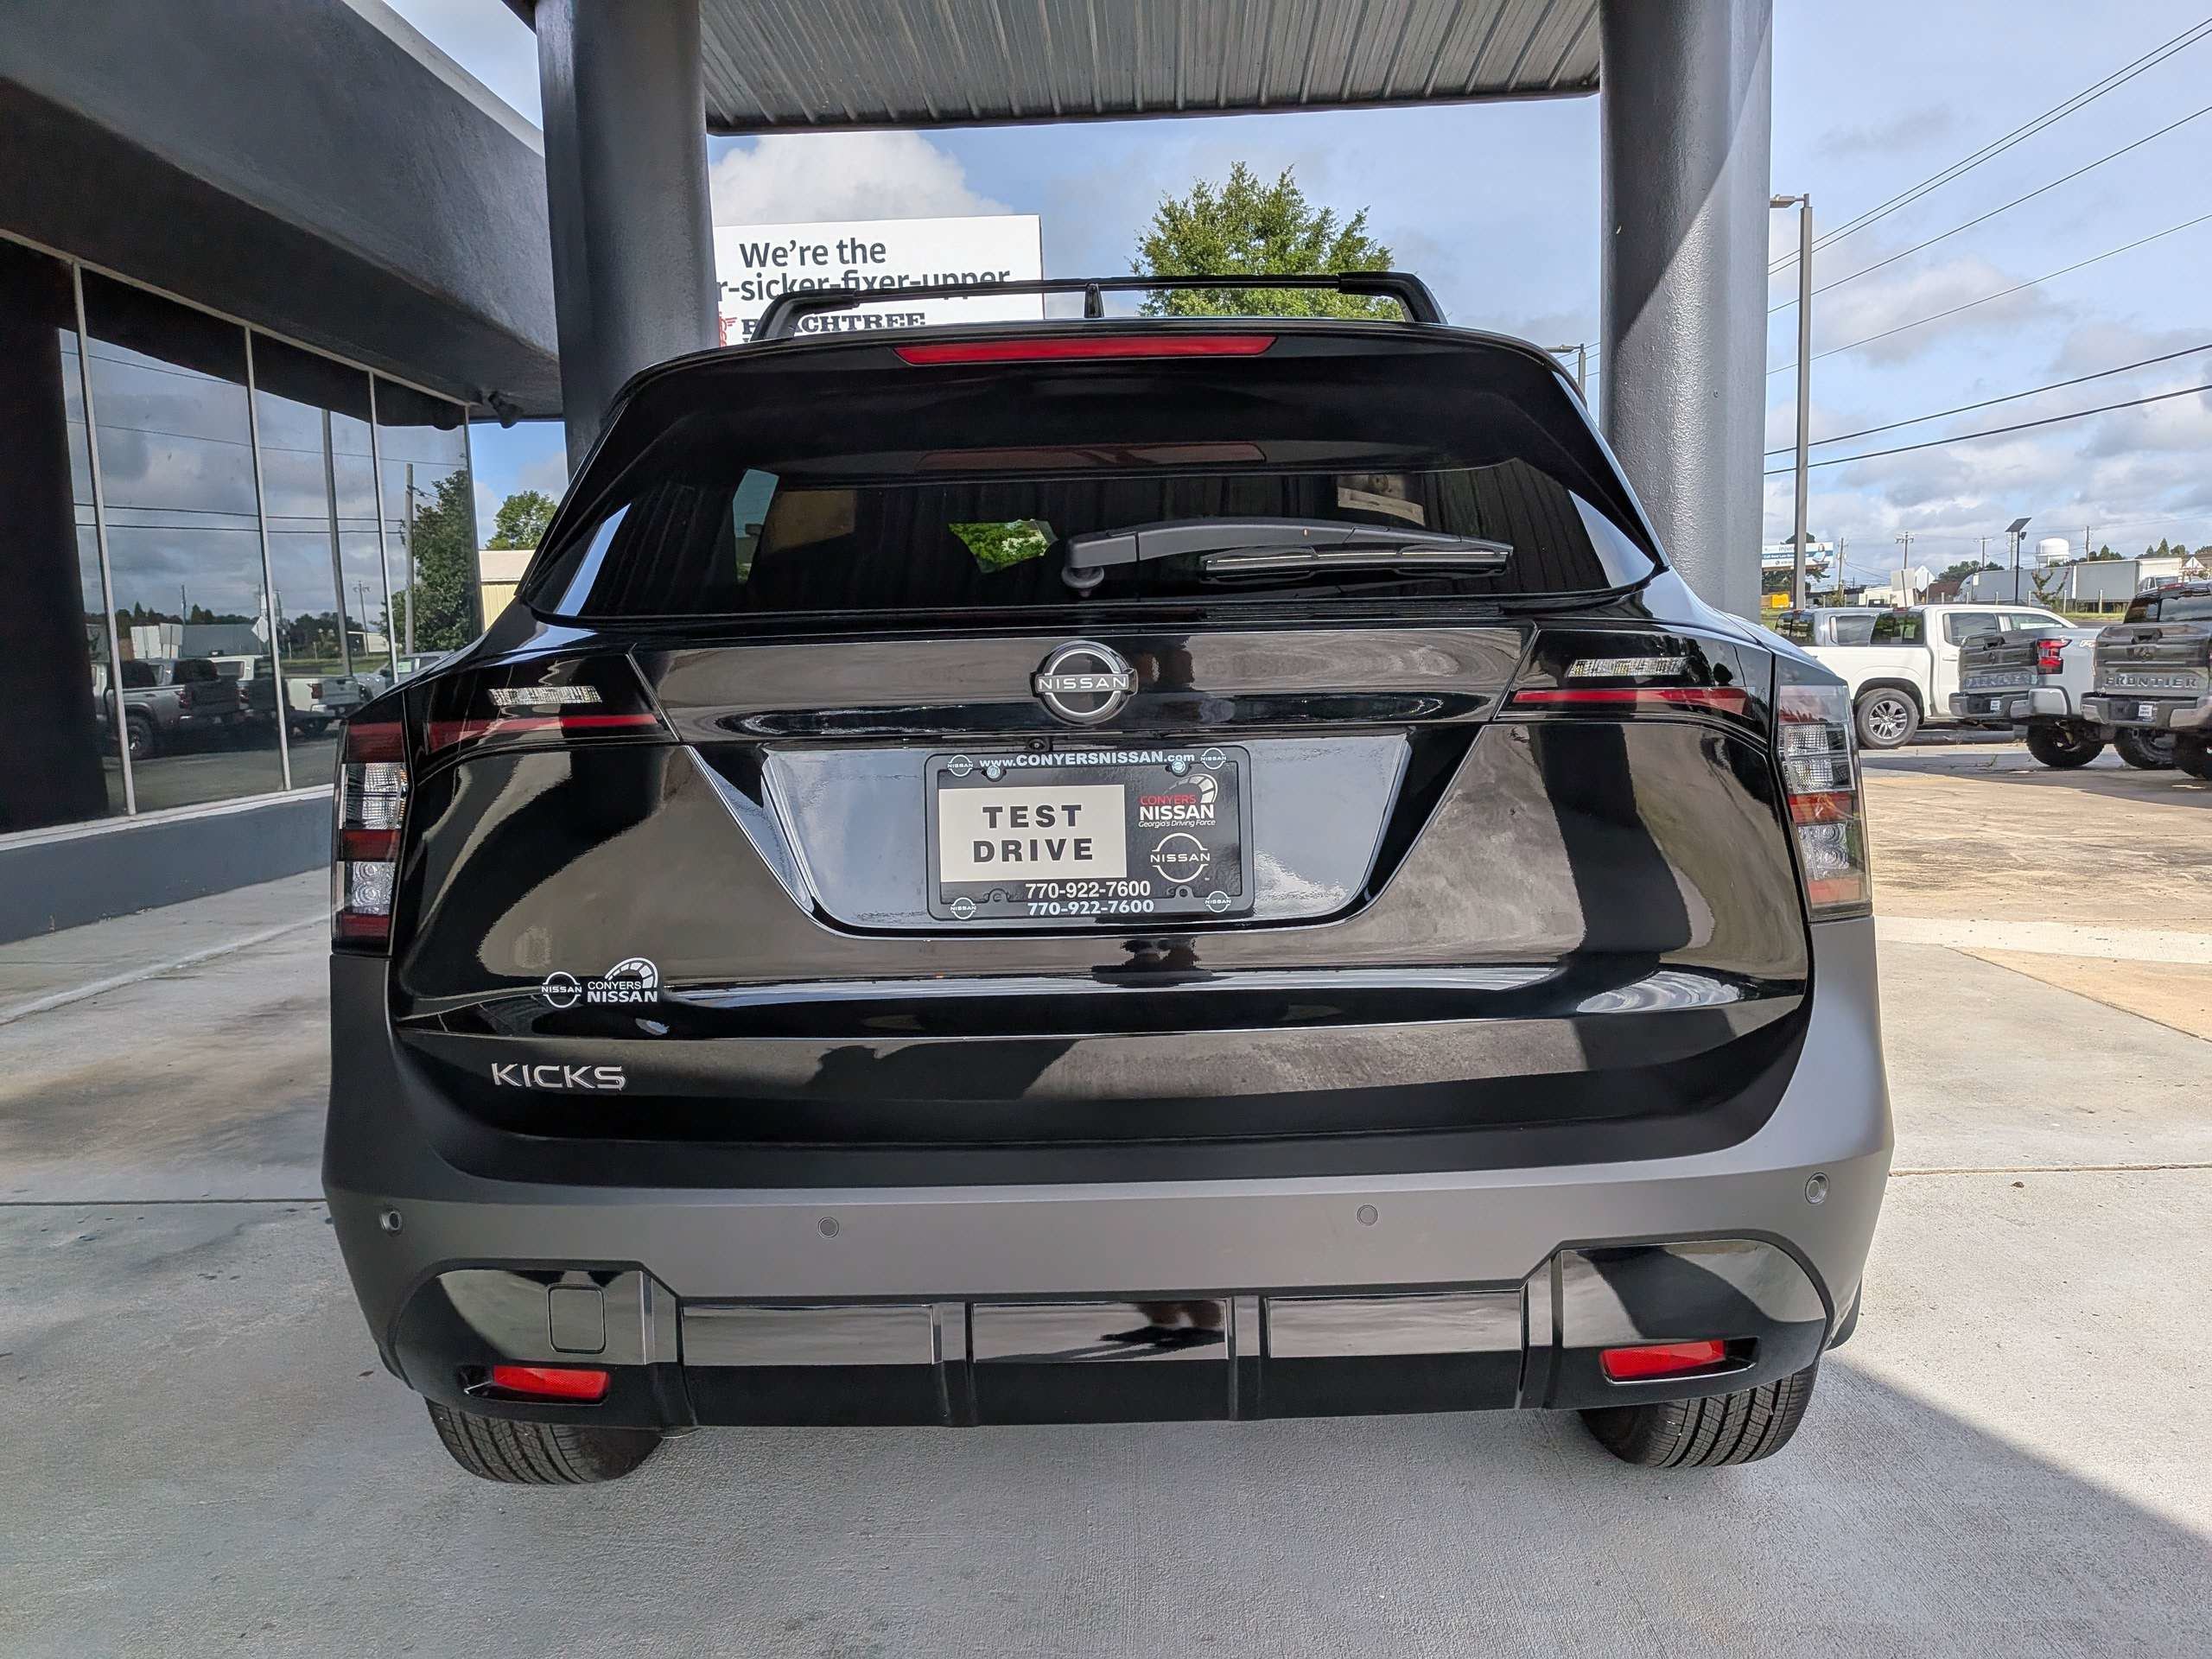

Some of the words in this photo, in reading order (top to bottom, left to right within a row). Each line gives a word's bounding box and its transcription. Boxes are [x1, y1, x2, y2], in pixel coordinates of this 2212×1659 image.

[739, 239, 830, 269] We’re
[836, 237, 887, 264] the
[741, 313, 926, 335] PCHTREE
[1039, 677, 1127, 690] NISSAN
[2105, 676, 2198, 689] FRONTIER
[979, 751, 1195, 767] www.CONYERSNISSAN.com
[1140, 795, 1197, 805] CONYERS
[982, 804, 1082, 829] TEST
[1140, 804, 1214, 820] NISSAN
[973, 838, 1093, 863] DRIVE
[1150, 853, 1211, 862] NISSAN
[1026, 880, 1151, 899] 770-922-7600
[1027, 899, 1154, 916] 770-922-7600
[587, 981, 642, 990] CONYERS
[587, 990, 658, 1003] NISSAN
[491, 1062, 628, 1090] KICKS
